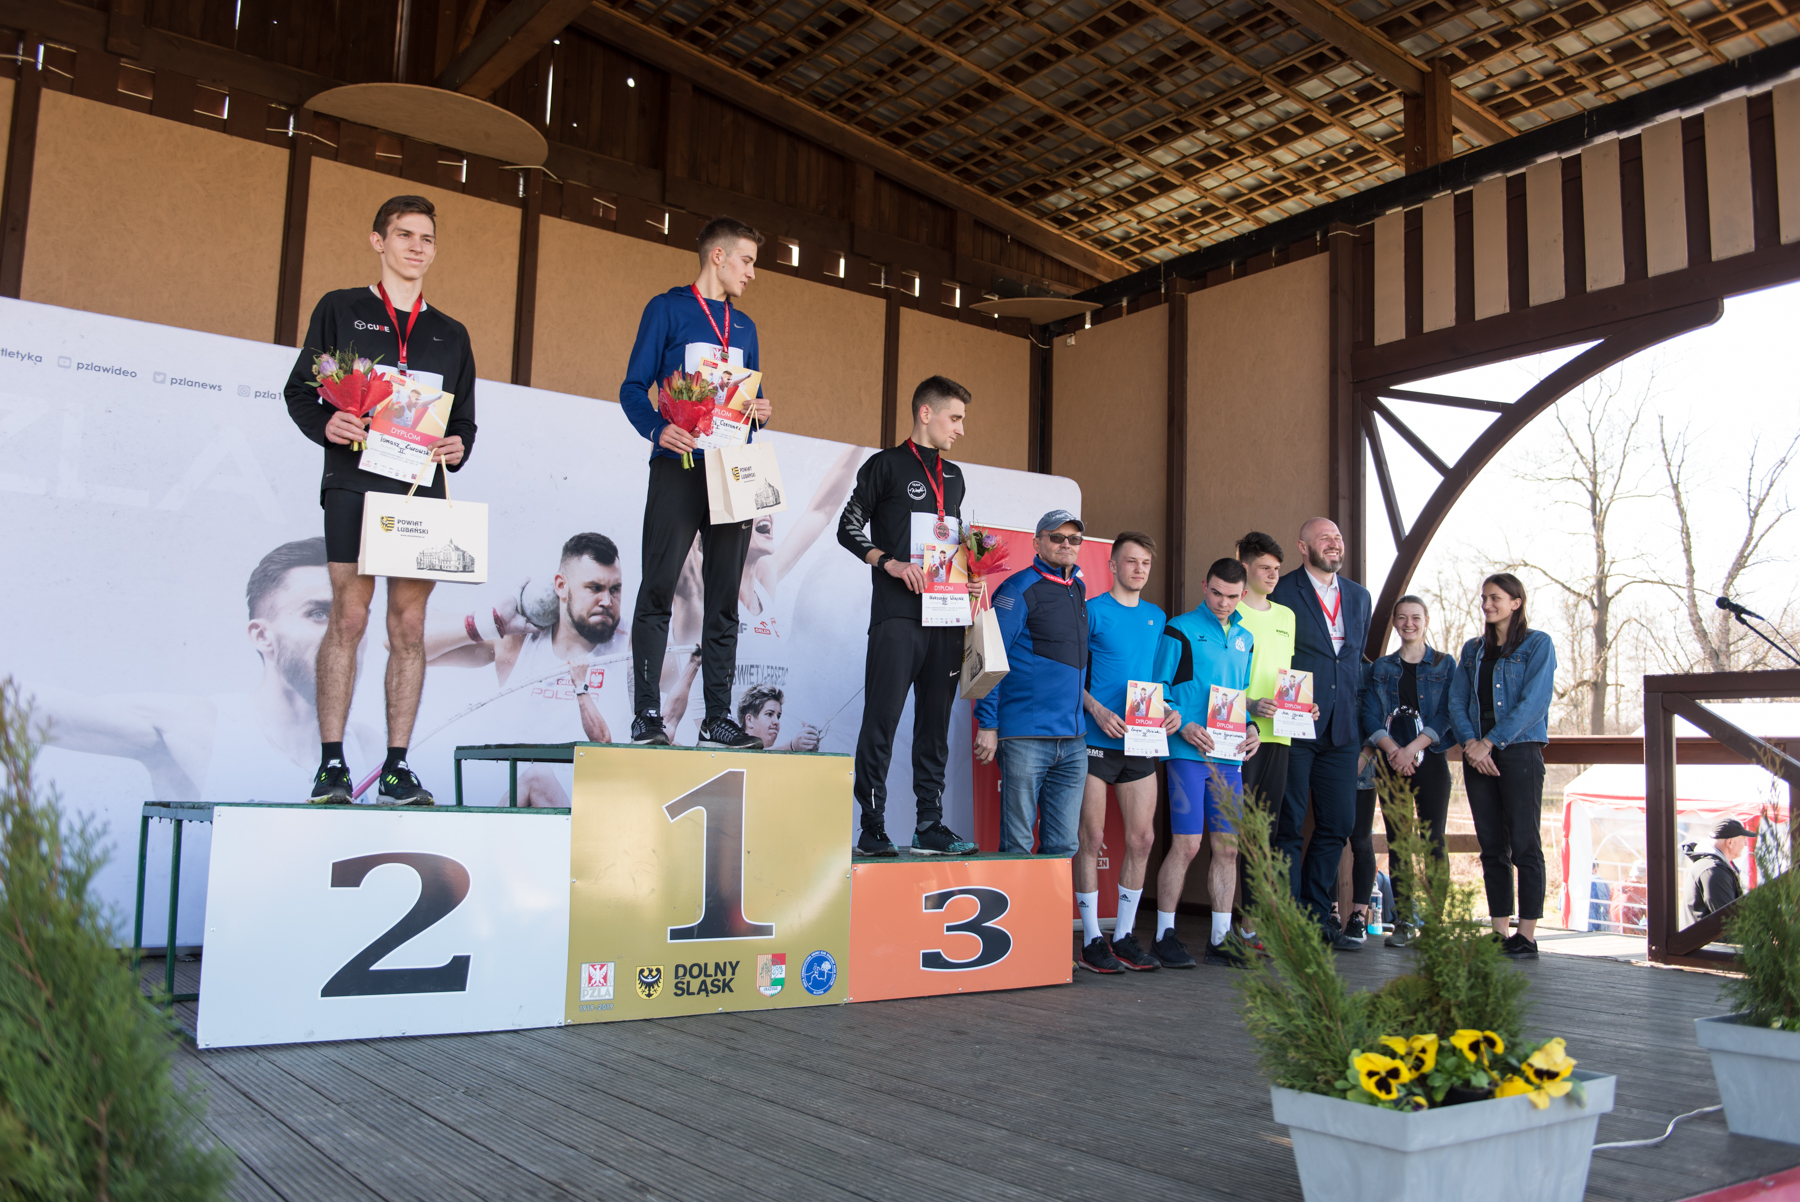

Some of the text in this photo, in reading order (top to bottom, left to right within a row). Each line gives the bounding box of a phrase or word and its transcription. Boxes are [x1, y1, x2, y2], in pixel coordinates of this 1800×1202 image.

[367, 323, 390, 333] CUBE
[76, 361, 138, 379] pzlawideo
[170, 377, 223, 392] pzlanews
[391, 427, 421, 442] DYPLOM
[397, 519, 423, 527] POWIAT
[397, 526, 429, 535] LUBAŃSKI
[662, 768, 775, 944] 1
[318, 850, 473, 999] 2
[920, 886, 1014, 972] 3
[675, 961, 741, 980] DOLNY
[582, 987, 612, 999] PZLA
[673, 976, 735, 998] ŚLĄSK
